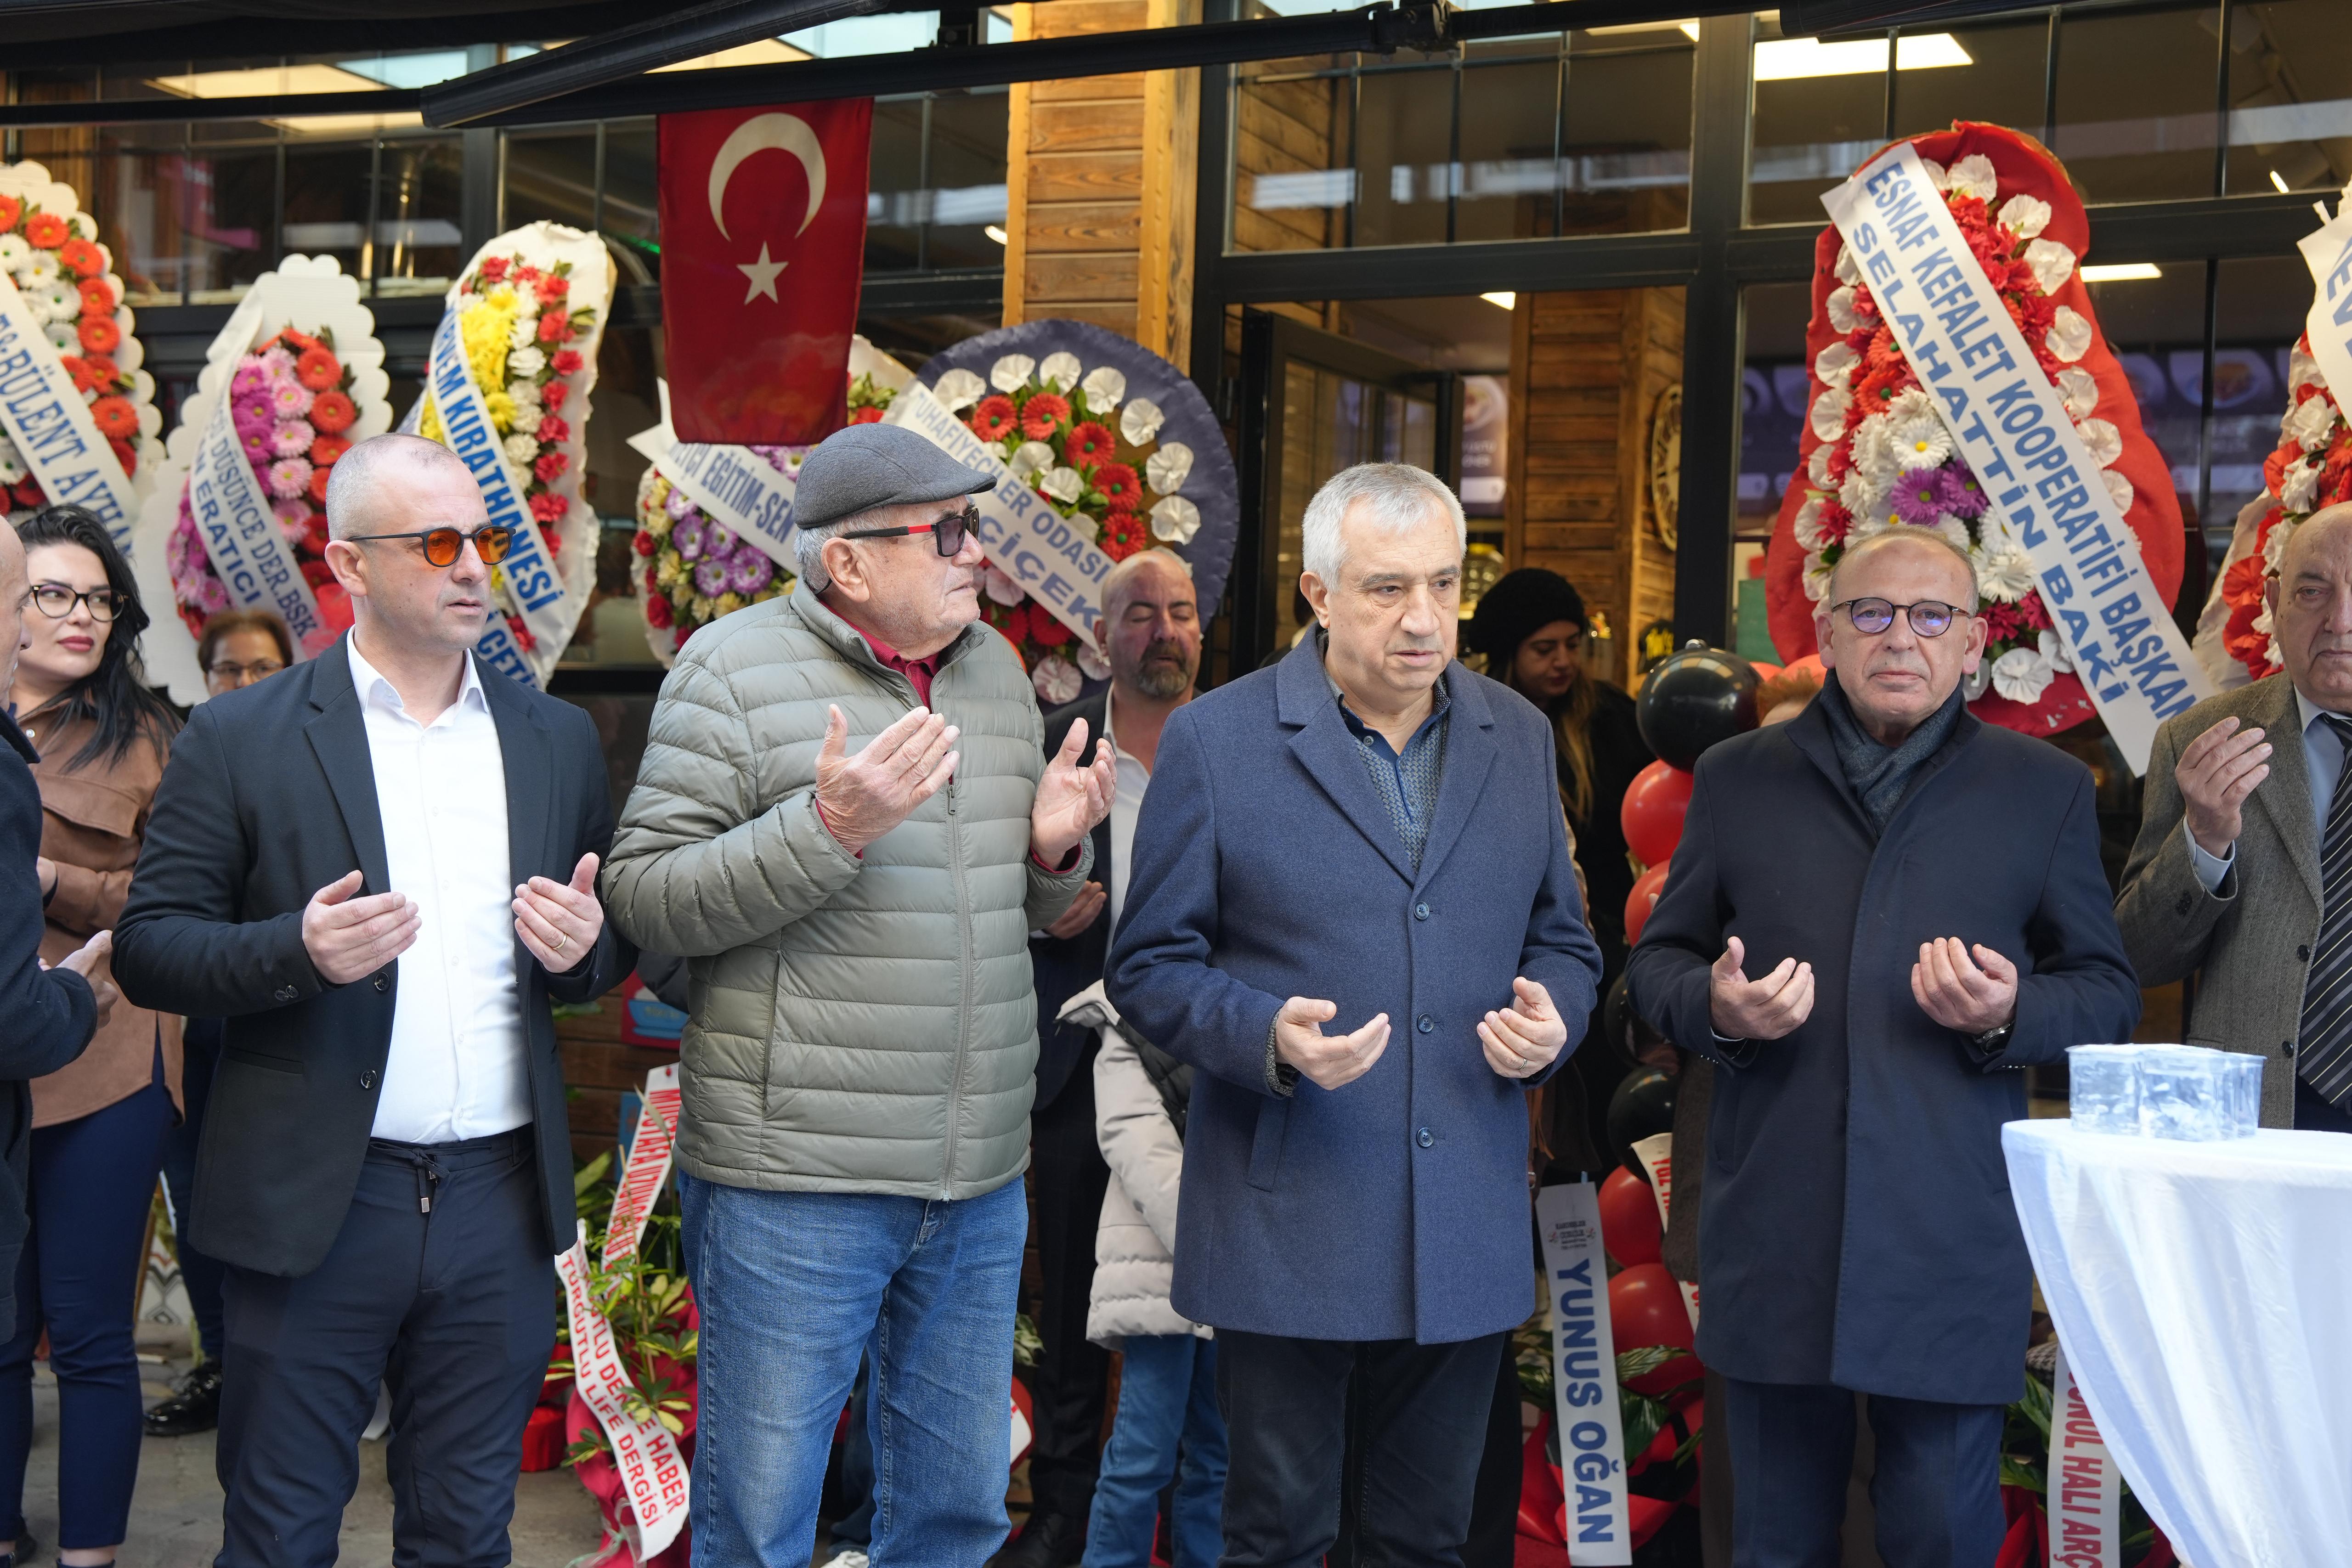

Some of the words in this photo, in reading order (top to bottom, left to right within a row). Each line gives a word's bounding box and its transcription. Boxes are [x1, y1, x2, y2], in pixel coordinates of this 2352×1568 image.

[1865, 162, 1939, 252] ESNAF
[1911, 247, 2016, 382] KEFALET
[1986, 378, 2138, 598] KOOPERATİFİ
[444, 395, 565, 613] KIRATHANESİ
[1853, 222, 2047, 550] SELAHATTİN
[2041, 564, 2130, 704] BAKİ
[1032, 512, 1111, 585] ODASI
[562, 1255, 591, 1379] TURGUTLU
[585, 1384, 624, 1431] LİFE
[618, 1433, 663, 1529] DERGİSİ
[1557, 1259, 1602, 1408] YUNUS
[646, 1433, 686, 1515] HABER
[1570, 1421, 1619, 1543] OĞAN
[2062, 1455, 2103, 1514] HALI
